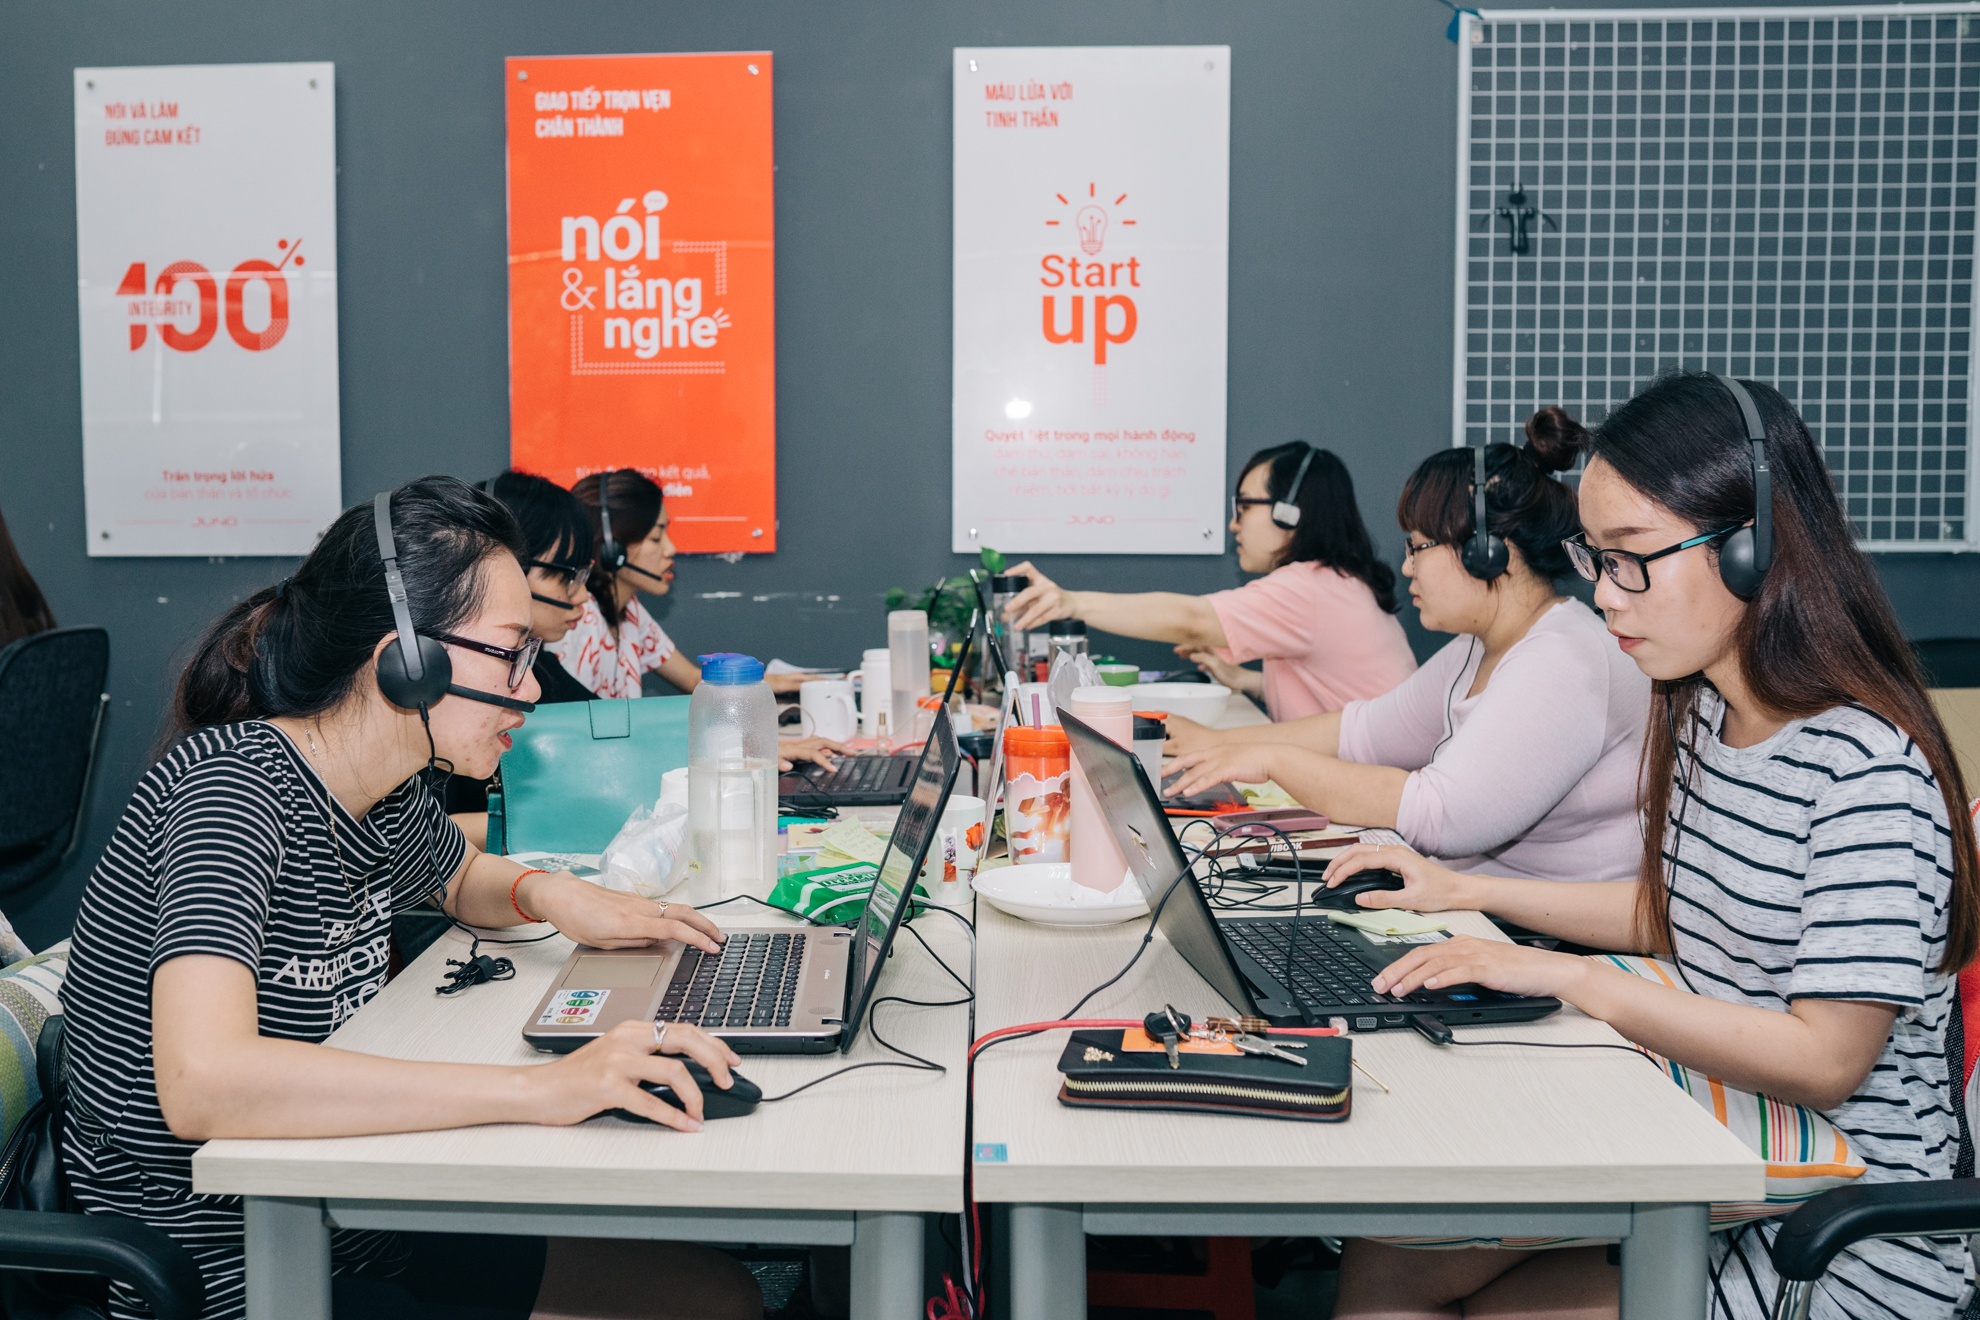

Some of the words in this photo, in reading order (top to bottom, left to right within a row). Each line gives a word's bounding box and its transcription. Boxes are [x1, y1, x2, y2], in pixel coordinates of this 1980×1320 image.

[534, 91, 568, 112] GIAO
[570, 85, 602, 111] TIẾP
[602, 90, 640, 114] TRỌN
[642, 89, 671, 113] VẸN
[535, 115, 574, 138] CHÂN
[575, 114, 624, 137] THÀNH
[986, 109, 1017, 128] TINH
[143, 128, 173, 145] CAM
[561, 189, 668, 262] nói
[1040, 254, 1141, 288] Start
[560, 267, 598, 312] &
[605, 264, 702, 320] lắng
[128, 299, 192, 318] INTEGRITY
[604, 313, 719, 359] nghe
[1042, 294, 1138, 365] up
[1053, 429, 1090, 443] trong
[1094, 429, 1120, 443] mọi
[1160, 428, 1197, 444] động
